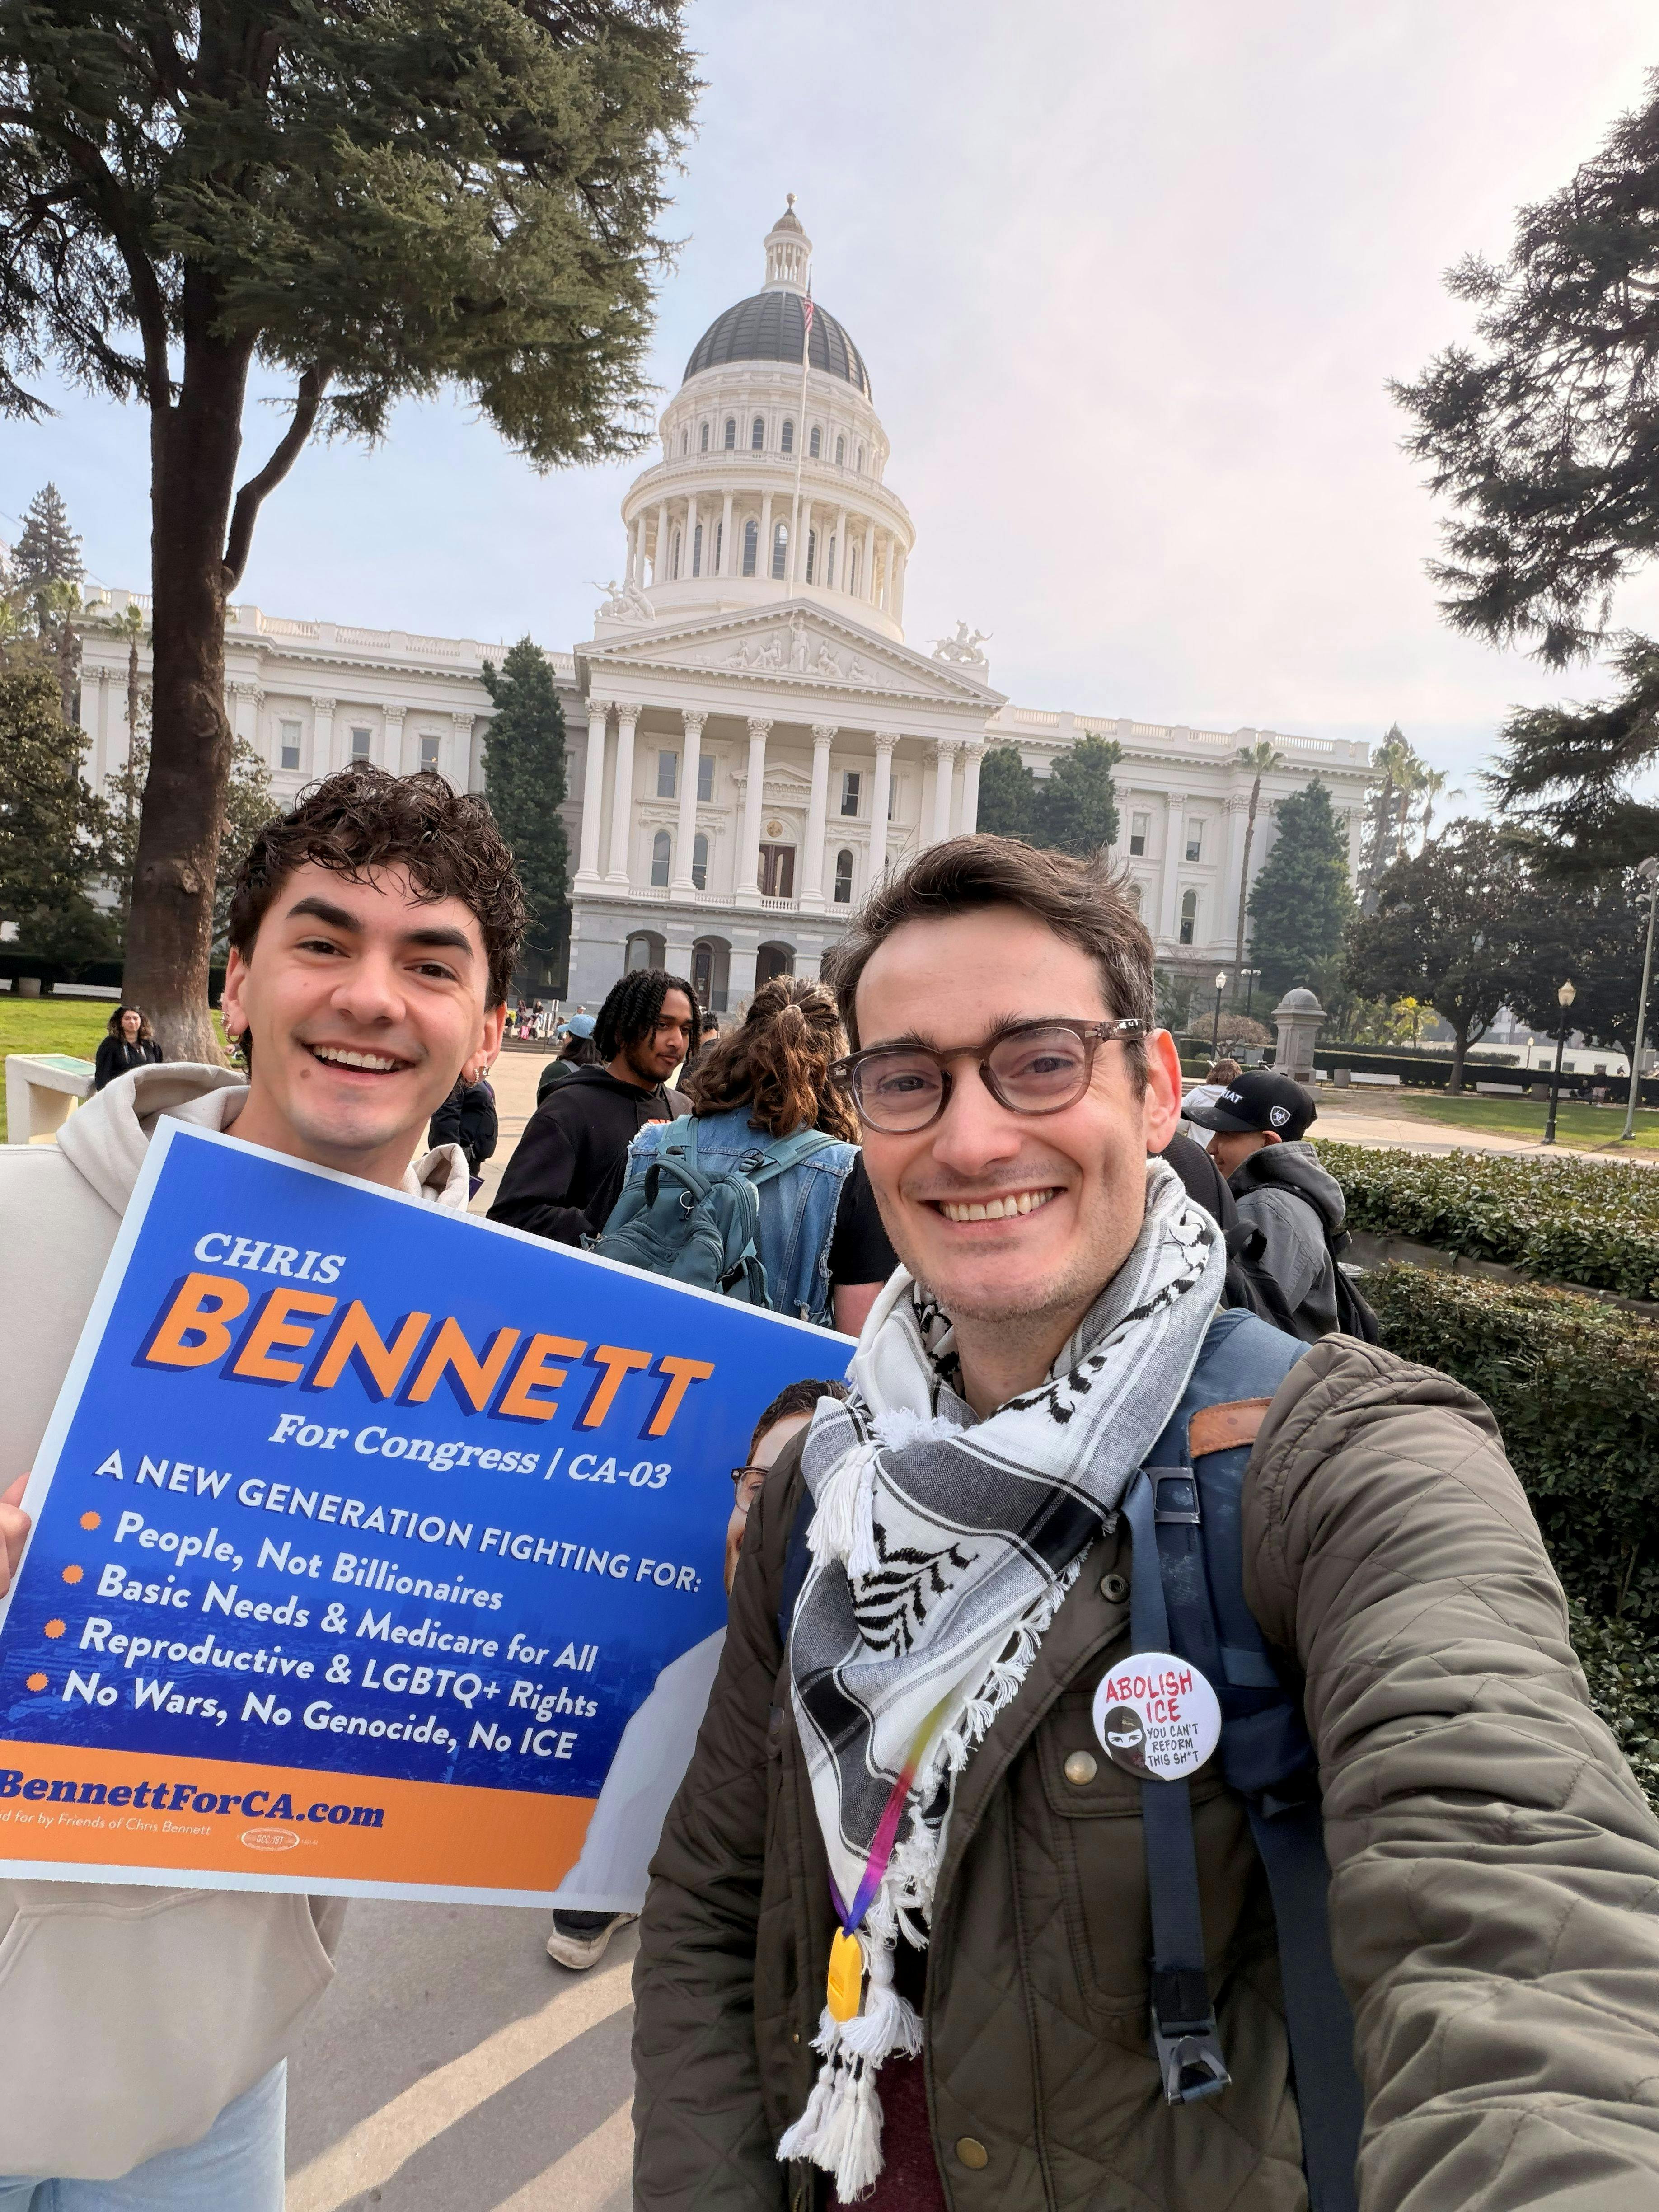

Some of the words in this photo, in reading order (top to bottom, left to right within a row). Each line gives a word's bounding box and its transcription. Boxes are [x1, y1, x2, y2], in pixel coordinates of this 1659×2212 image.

[194, 1233, 347, 1284] CHRIS
[132, 1273, 715, 1441] BENNETT
[268, 1413, 349, 1450] For
[354, 1426, 540, 1474] Congress
[568, 1454, 672, 1489] CA-03
[94, 1448, 124, 1481] A
[136, 1455, 232, 1499] NEW
[238, 1478, 473, 1550] GENERATION
[479, 1527, 631, 1579] FIGHTING
[635, 1558, 702, 1593] FOR:
[114, 1511, 244, 1572] People,
[256, 1537, 323, 1579] Not
[331, 1552, 504, 1610] Billionaires
[97, 1563, 192, 1608] Basic
[202, 1581, 310, 1628] Needs
[321, 1602, 348, 1634] &
[356, 1607, 499, 1658] Medicare
[506, 1633, 550, 1665] for
[552, 1642, 599, 1672] All
[79, 1616, 315, 1679] Reproductive
[325, 1654, 352, 1684] &
[361, 1659, 501, 1709] LGBTQ+
[508, 1680, 598, 1723] Rights
[1106, 1669, 1193, 1703] ABOLISH
[61, 1669, 118, 1706] No
[135, 1678, 228, 1727] Wars,
[241, 1691, 292, 1726] No
[303, 1701, 457, 1754] Genocide,
[468, 1720, 512, 1752] No
[520, 1727, 578, 1759] ICE
[1146, 1698, 1181, 1724] ICE
[1147, 1727, 1167, 1739] YOU
[1170, 1723, 1199, 1737] CAN'T
[1147, 1755, 1170, 1767] THIS
[1152, 1738, 1194, 1753] REFORM
[0, 1768, 384, 1828] BennettForCA.com
[15, 1809, 35, 1823] for
[37, 1811, 55, 1829] by
[58, 1812, 106, 1829] Friends
[108, 1817, 125, 1829] of
[126, 1817, 158, 1832] Chris
[162, 1820, 211, 1836] Bennett
